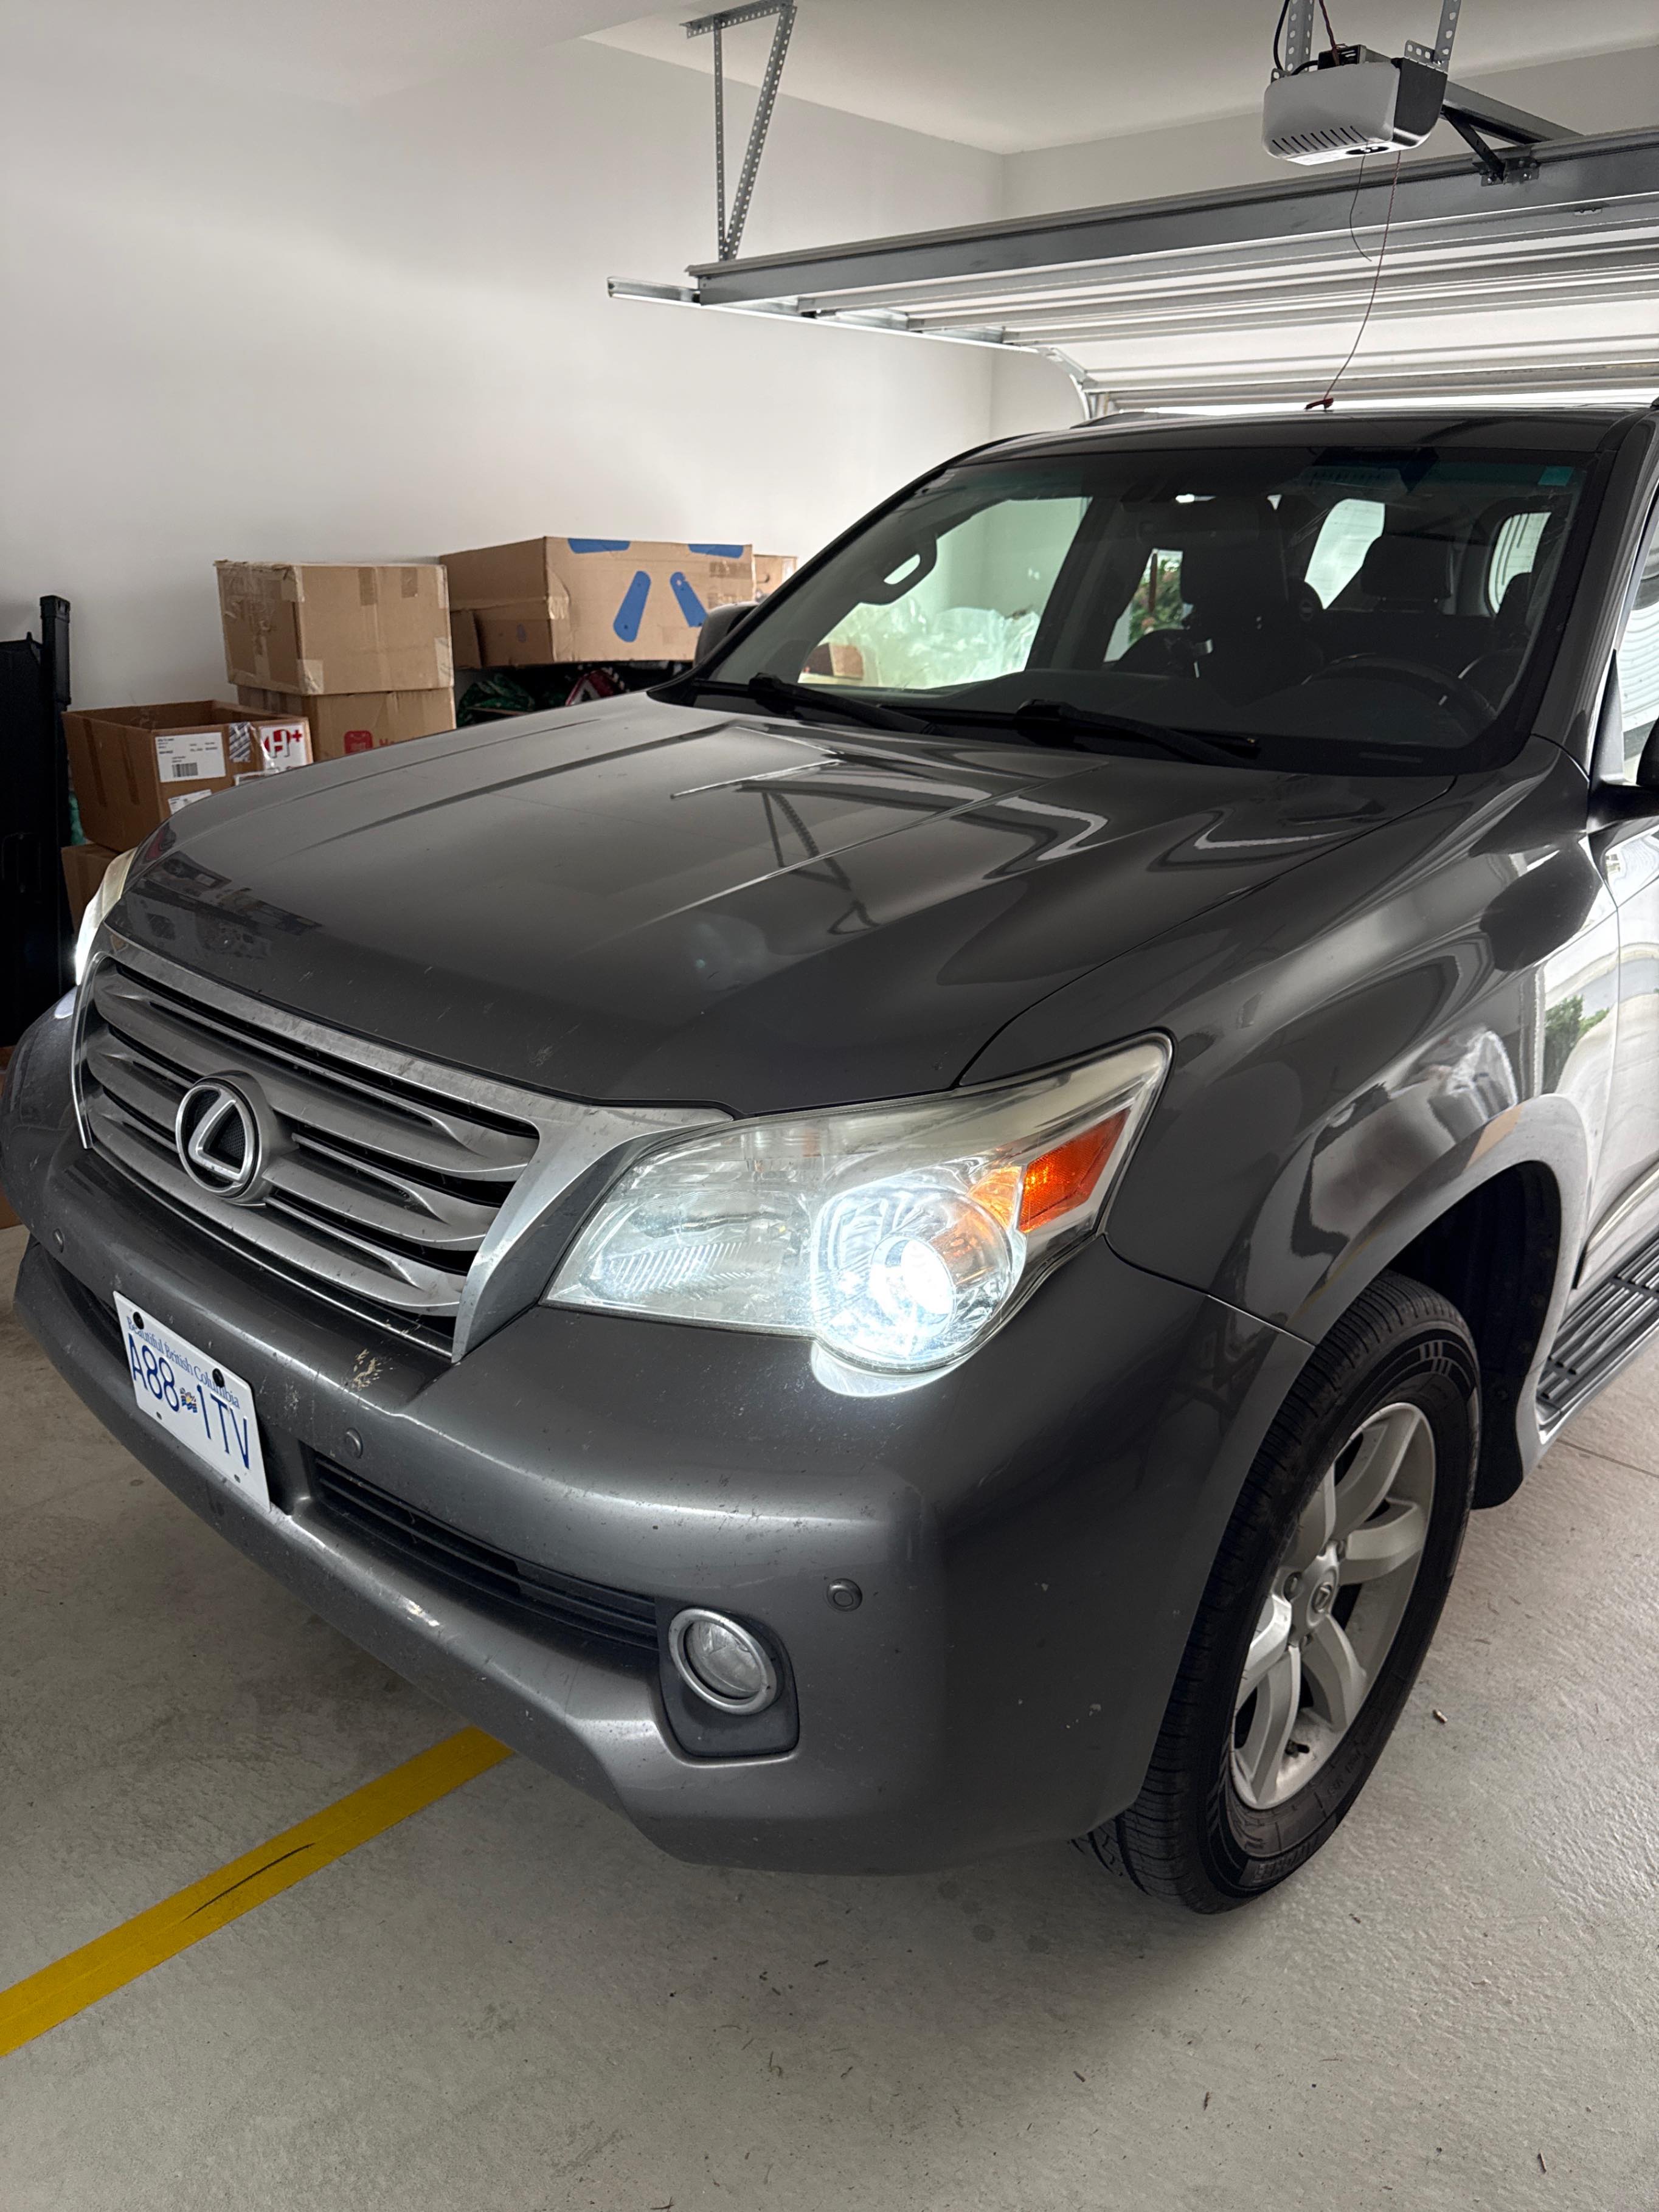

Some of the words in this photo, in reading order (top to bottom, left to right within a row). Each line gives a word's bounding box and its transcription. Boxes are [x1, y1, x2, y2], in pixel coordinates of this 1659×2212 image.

[126, 1316, 164, 1354] Beautiful
[164, 1342, 193, 1376] British
[193, 1366, 240, 1409] Columbia
[128, 1333, 180, 1412] A88
[196, 1383, 250, 1470] 1TV
